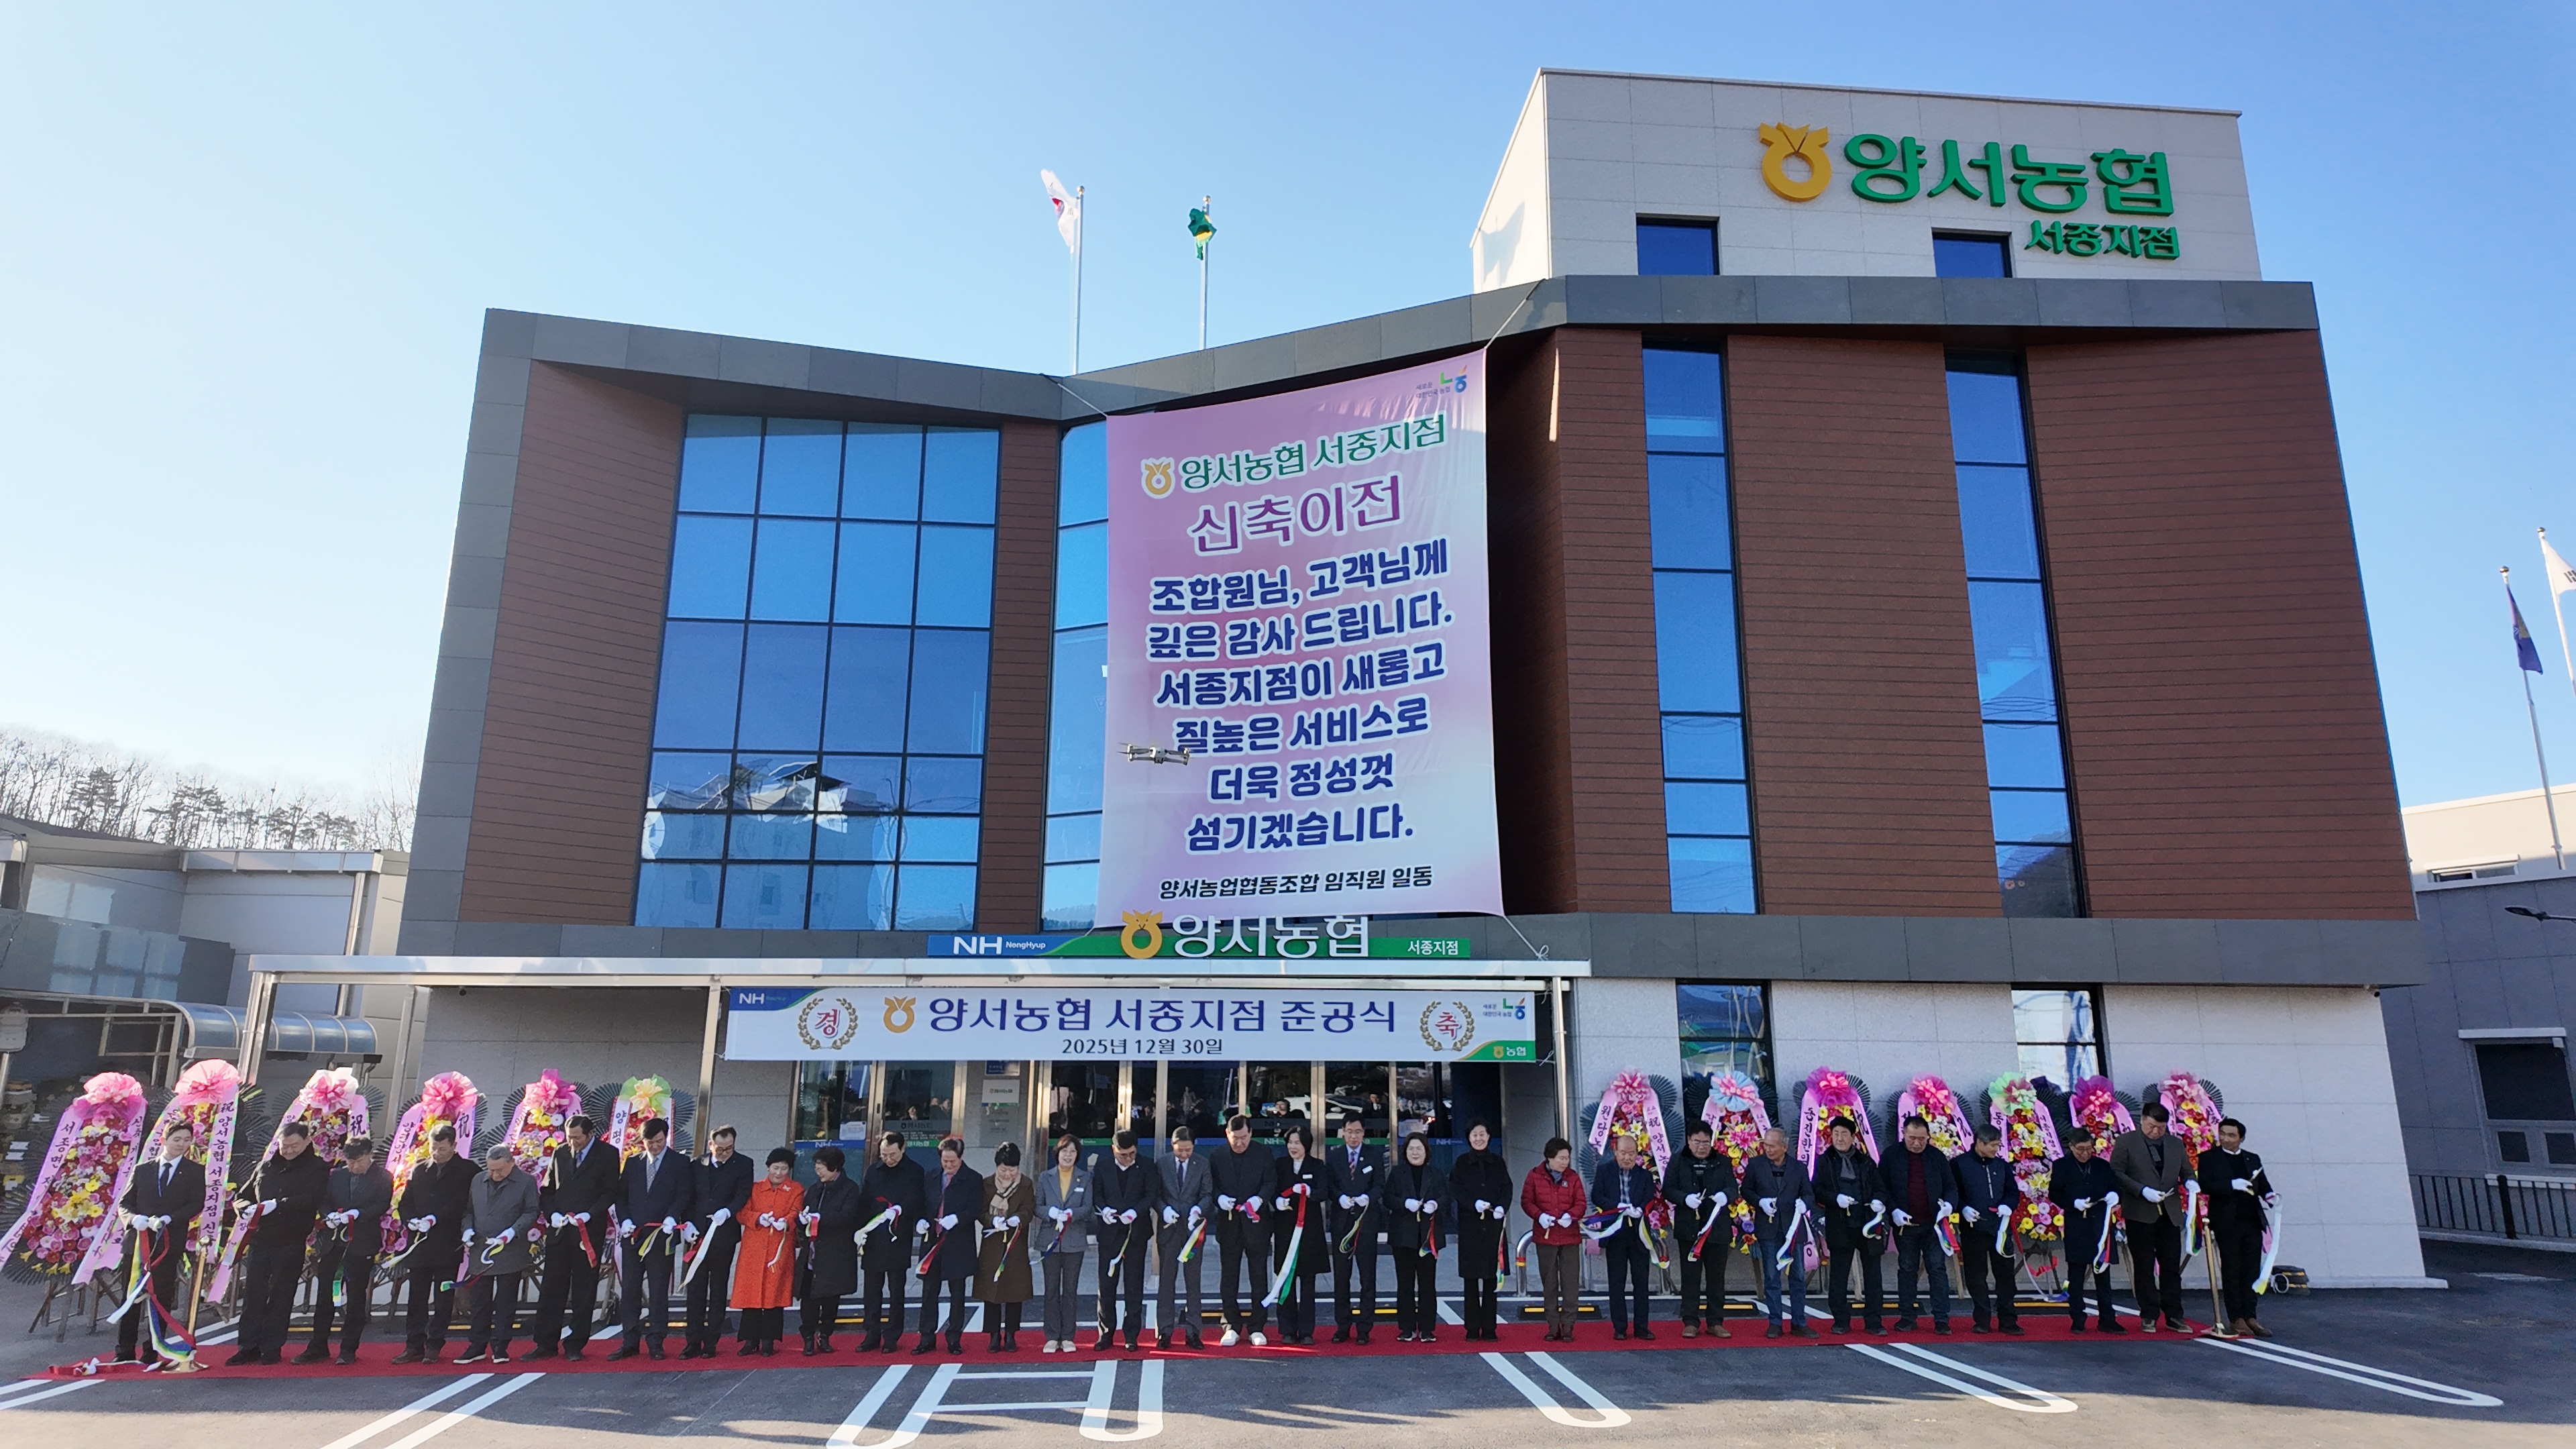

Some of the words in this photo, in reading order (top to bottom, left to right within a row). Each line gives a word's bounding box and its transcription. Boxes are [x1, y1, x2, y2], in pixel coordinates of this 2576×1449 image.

[1844, 133, 2174, 216] 양서농협
[2025, 219, 2180, 260] 서종지점
[1182, 443, 1304, 489] 양서농협
[1313, 414, 1446, 468] 서종지점
[1191, 475, 1401, 553] 신축이전
[1152, 569, 1300, 611] 조합원님,
[1309, 538, 1448, 598] 고객님께
[1150, 625, 1217, 658] 깊은
[1228, 616, 1295, 656] 감사
[1303, 591, 1452, 647] 드립니다.
[1157, 661, 1332, 706] 서종지점이
[1342, 642, 1445, 692] 새롭고
[1175, 716, 1280, 753] 질높은
[1291, 697, 1428, 747] 서비스로
[1211, 765, 1279, 800] 더욱
[1291, 753, 1394, 797] 정성껏
[1187, 803, 1413, 851] 섬기겠습니다.
[1160, 873, 1320, 900] 양서농업협동조합
[1324, 869, 1386, 892] 임직원
[1391, 865, 1433, 887] 일동
[953, 936, 1002, 955] NH
[1006, 941, 1046, 950] NongHyup
[1172, 915, 1369, 959] 양서농협
[1407, 940, 1459, 956] 서종지점
[739, 993, 765, 1004] NH
[929, 998, 1091, 1031] 양서농협
[1106, 999, 1265, 1032] 서종지점
[1281, 1000, 1395, 1033] 준공식
[814, 1008, 839, 1037] 경
[1434, 1012, 1460, 1039] 축
[1062, 1038, 1128, 1055] 2025년
[1134, 1038, 1175, 1055] 12월
[1181, 1038, 1223, 1055] 30일
[1507, 1046, 1526, 1057] 농협
[50, 1121, 76, 1169] 서종면
[212, 1116, 233, 1162] 양서농협
[350, 1114, 366, 1137] 祝
[458, 1112, 470, 1139] 祝
[1652, 1132, 1670, 1171] 양서농
[203, 1167, 223, 1218] 서종지점
